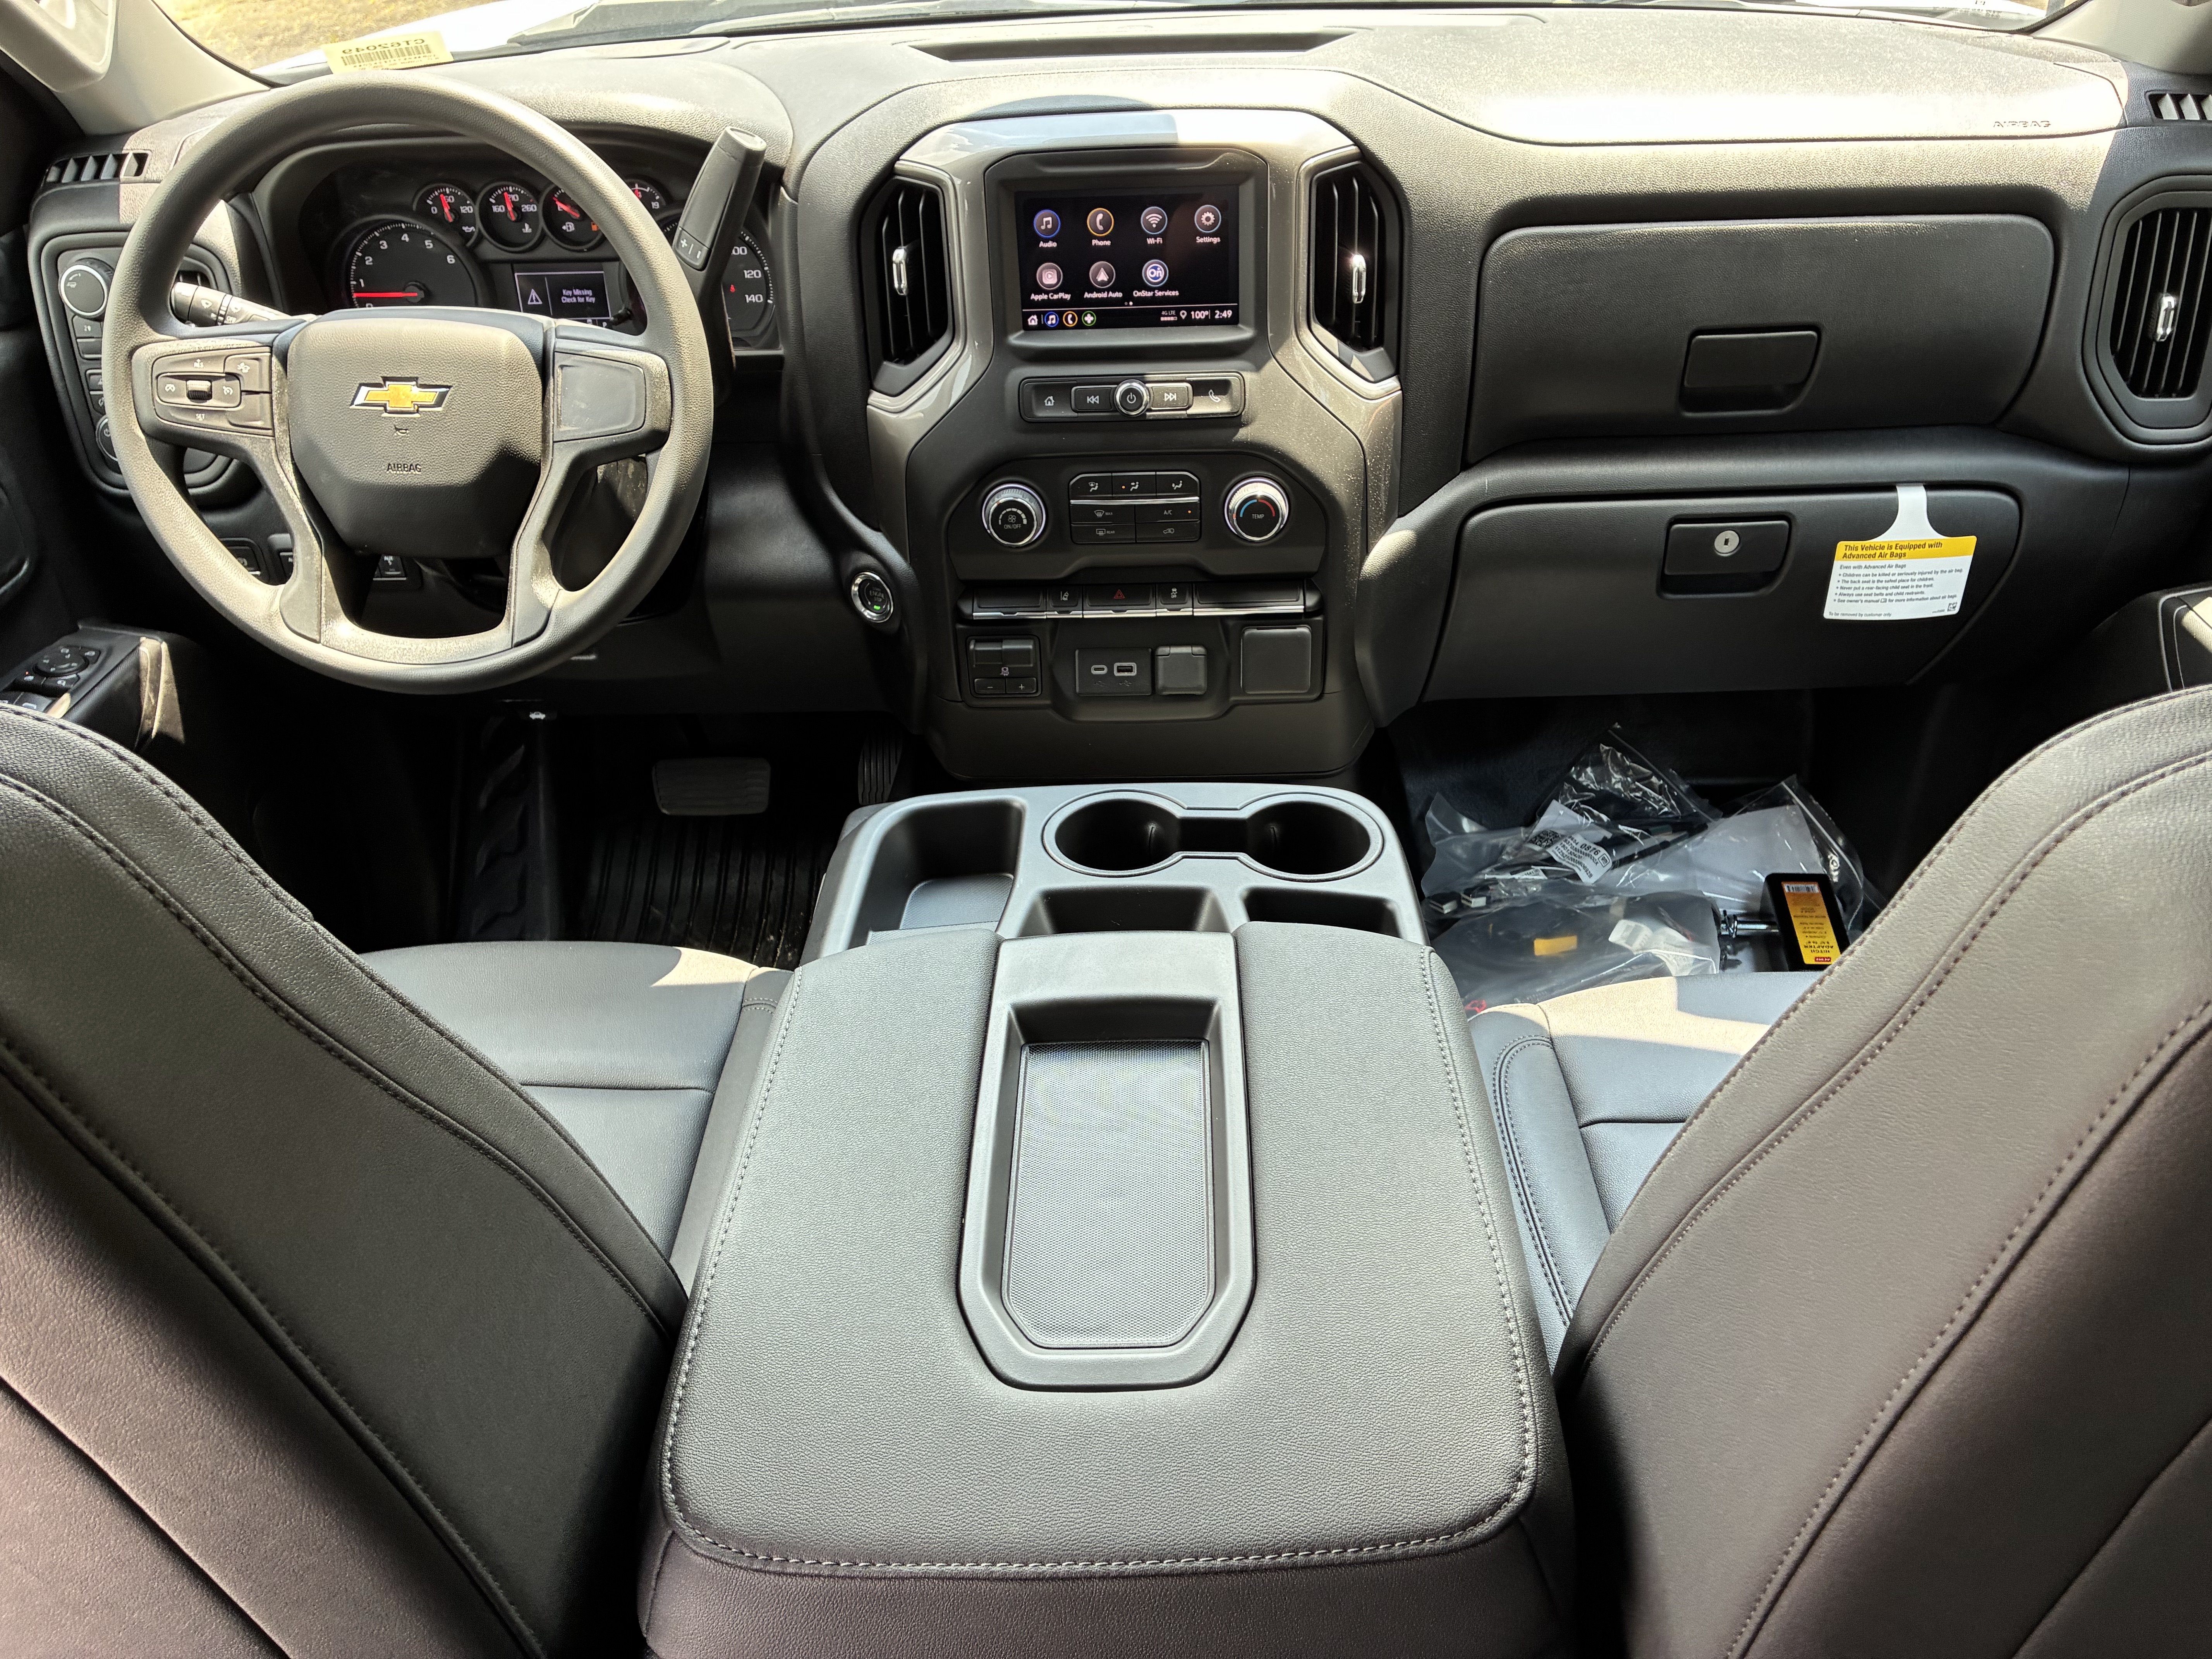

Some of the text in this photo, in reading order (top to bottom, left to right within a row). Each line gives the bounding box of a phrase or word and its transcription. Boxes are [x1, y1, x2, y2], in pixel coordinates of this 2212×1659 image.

[401, 234, 409, 242] 4
[379, 240, 388, 249] 3
[425, 240, 433, 249] 5
[731, 246, 747, 255] 00
[365, 256, 373, 265] 2
[447, 254, 455, 264] 6
[744, 270, 762, 278] 120
[359, 278, 364, 287] 1
[745, 294, 763, 303] 140
[1214, 310, 1232, 318] 2:49
[387, 463, 421, 474] AIRBAG
[1895, 542, 1926, 551] Equipped
